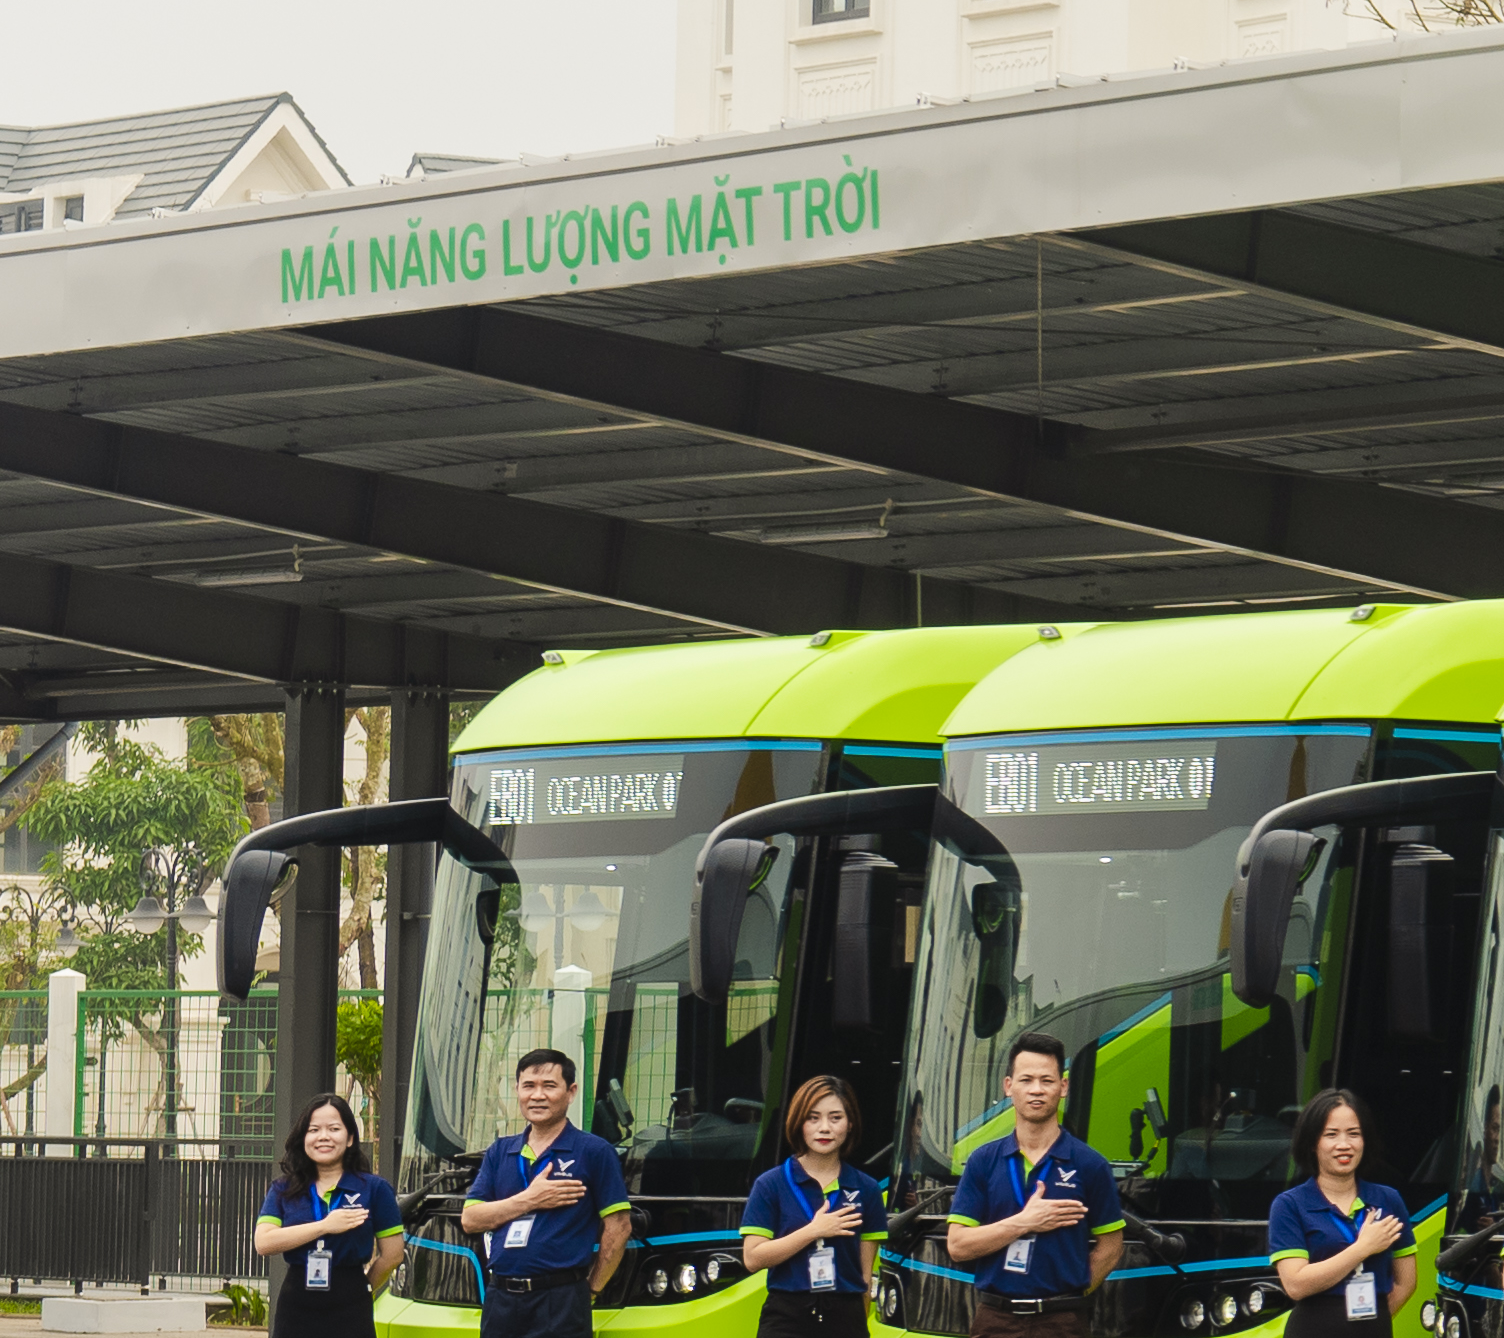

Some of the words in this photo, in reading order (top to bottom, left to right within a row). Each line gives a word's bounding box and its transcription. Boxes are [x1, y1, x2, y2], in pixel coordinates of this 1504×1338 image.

[281, 226, 355, 304] MÁI
[369, 216, 487, 294] NĂNG
[502, 201, 650, 286] LƯỢNG
[666, 174, 763, 265] MẶT
[774, 154, 880, 242] TRỜI
[488, 768, 536, 825] EB01
[546, 776, 608, 816] OCEAN
[609, 773, 660, 813] PARK
[984, 752, 1039, 814] EB01
[1052, 760, 1124, 804] OCEAN
[1126, 758, 1185, 800] PARK
